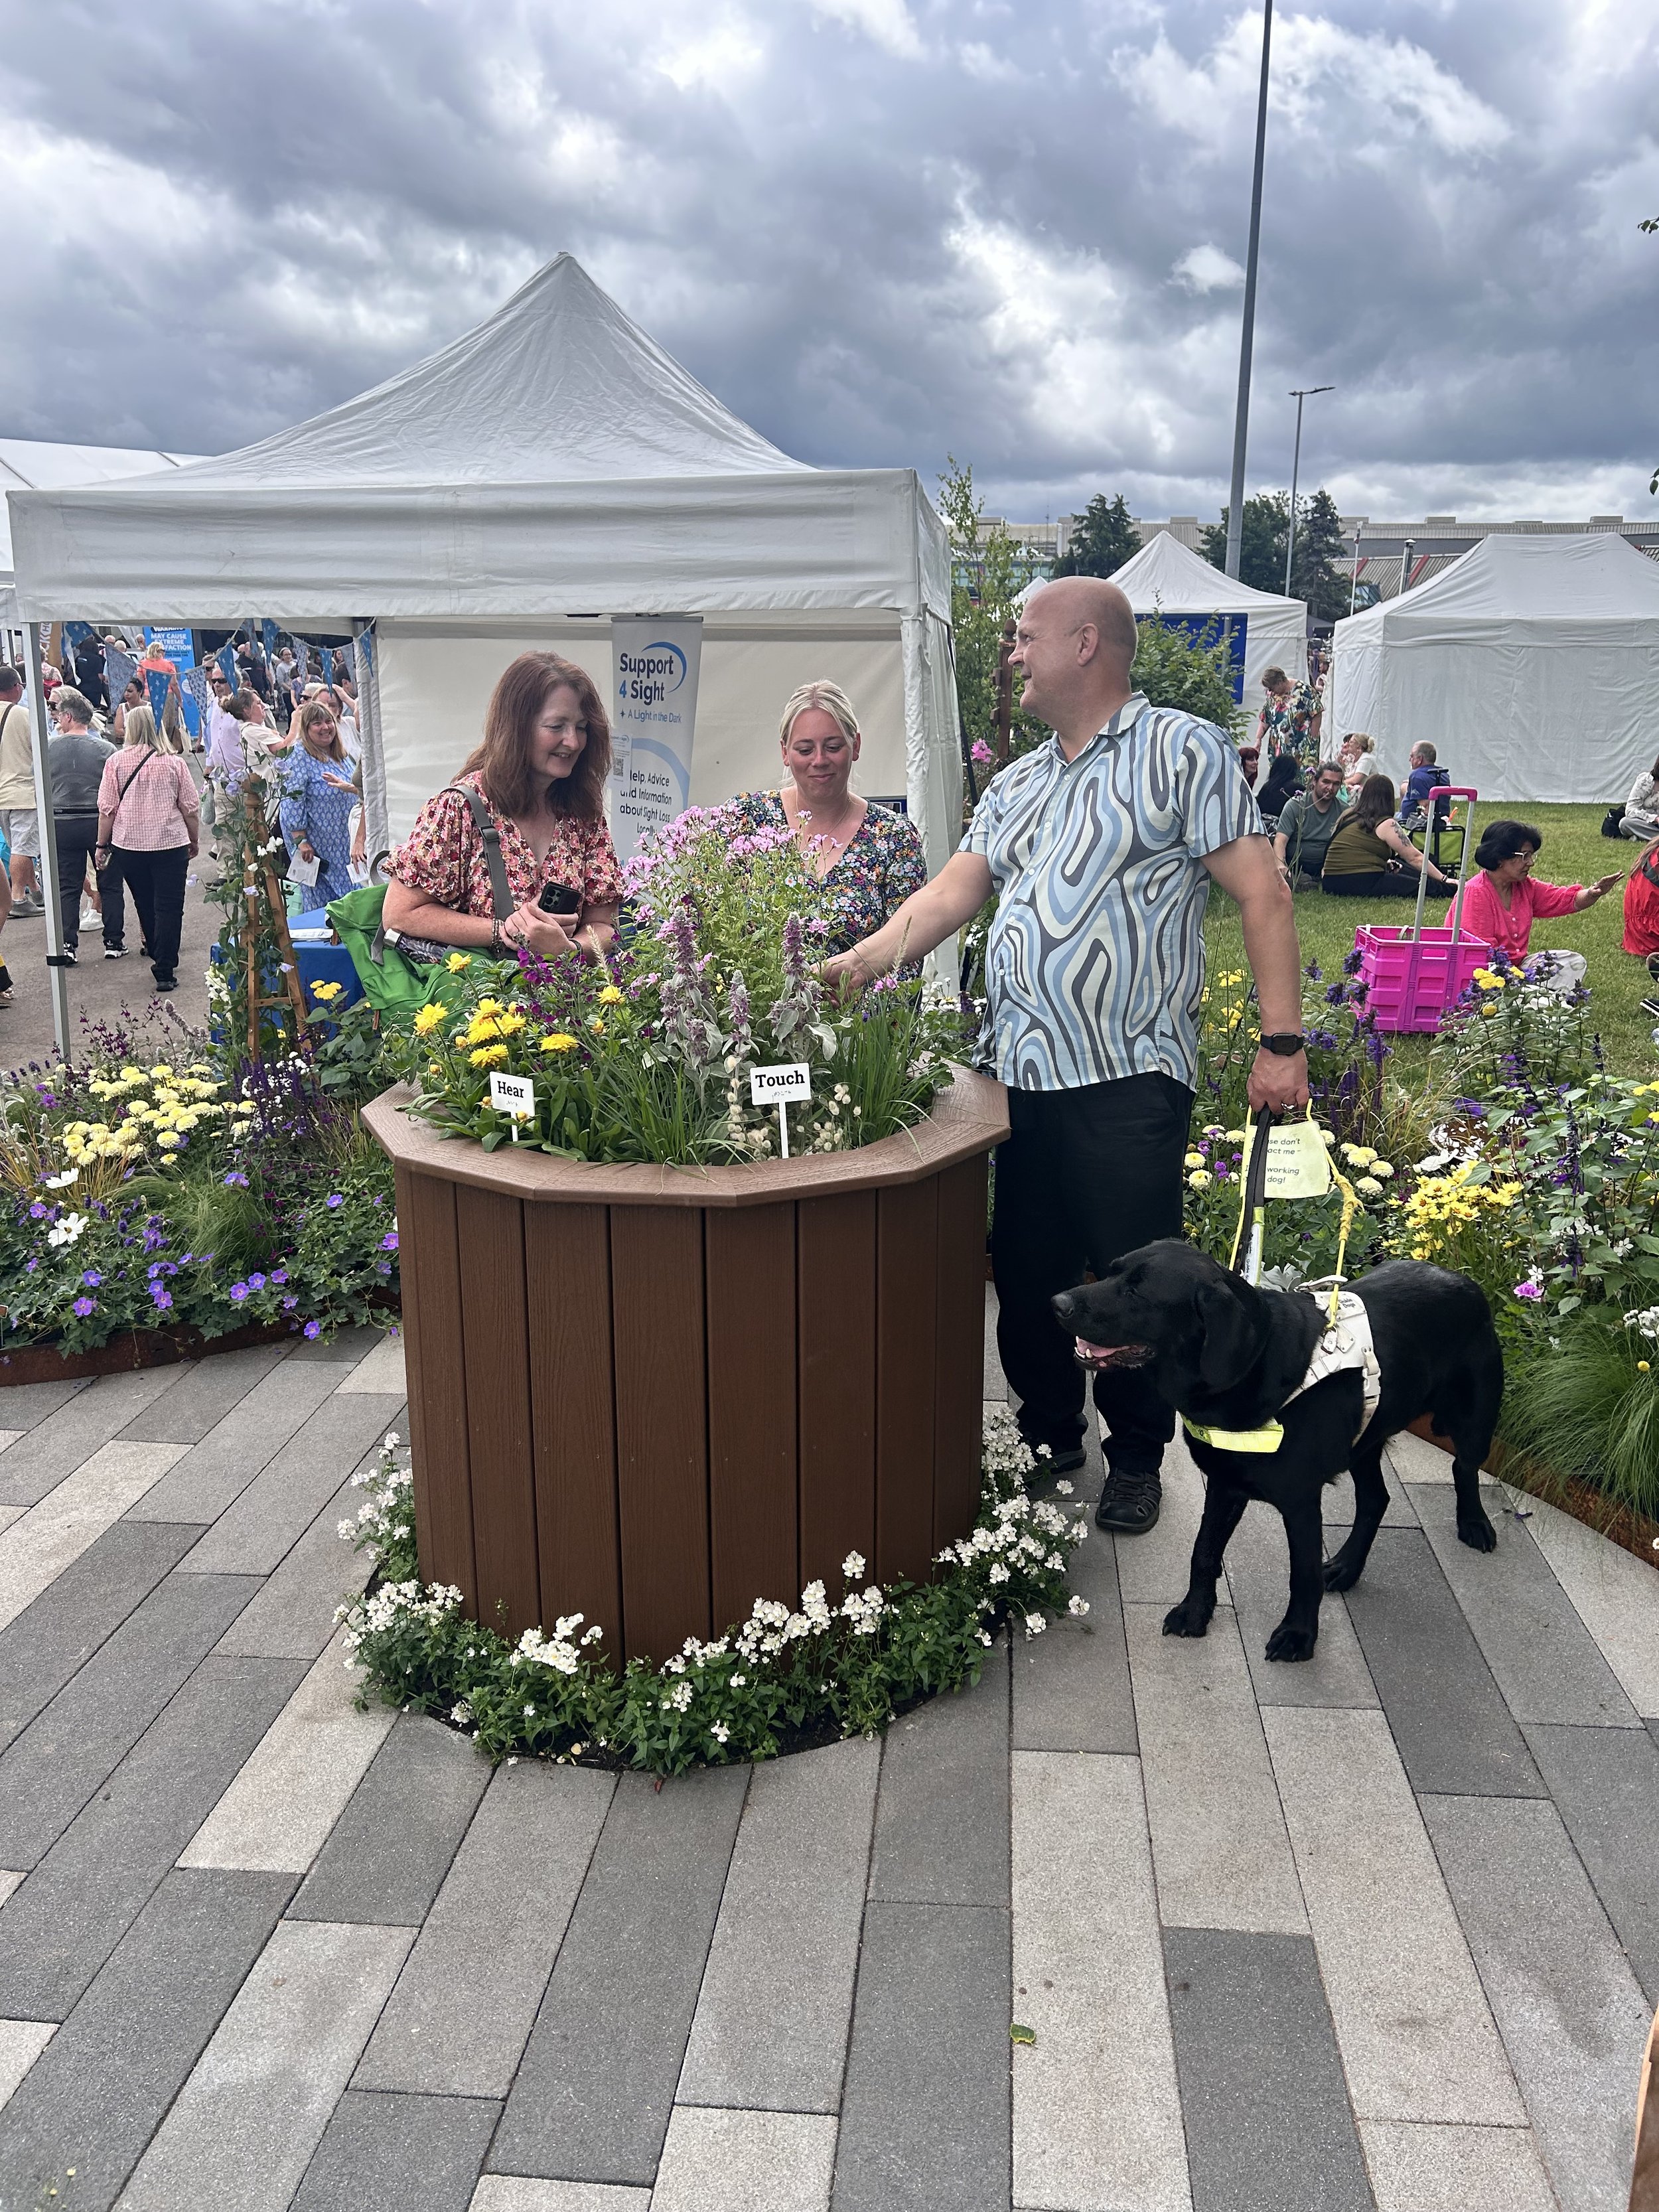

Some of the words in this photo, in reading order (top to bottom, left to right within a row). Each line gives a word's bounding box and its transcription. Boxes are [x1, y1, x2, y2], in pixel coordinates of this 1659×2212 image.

[620, 652, 674, 678] Support
[619, 680, 627, 698] 4
[630, 680, 664, 705] Sight
[628, 708, 633, 718] A
[634, 709, 652, 723] Light
[653, 711, 658, 721] in
[658, 711, 668, 722] the
[669, 712, 682, 723] Dark
[647, 773, 670, 787] Advice
[639, 788, 672, 806] Information
[620, 803, 642, 817] about
[643, 806, 658, 822] Sight
[659, 812, 670, 823] Loss
[755, 1070, 805, 1088] Touch
[497, 1080, 524, 1098] Hear
[1267, 1165, 1299, 1176] working
[1267, 1175, 1286, 1185] dog!
